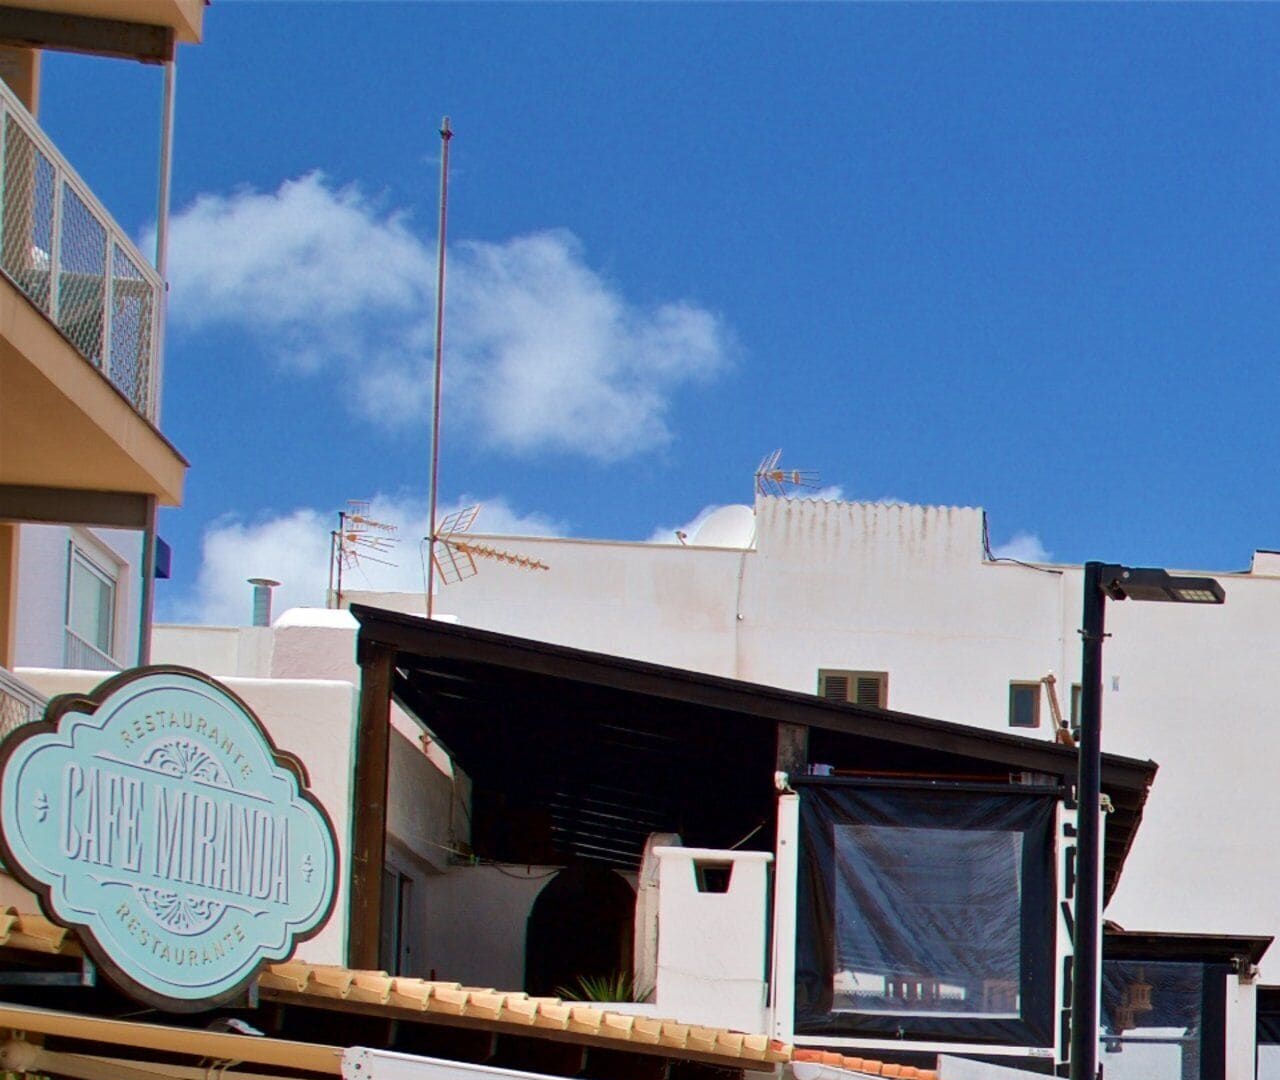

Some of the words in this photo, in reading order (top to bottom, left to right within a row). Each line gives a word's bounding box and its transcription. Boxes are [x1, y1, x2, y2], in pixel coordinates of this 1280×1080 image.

[119, 709, 254, 782] RESTAURANTE
[63, 761, 146, 875] CAFE
[151, 784, 291, 907] MIRANDA
[114, 900, 247, 968] RESTAURANTE
